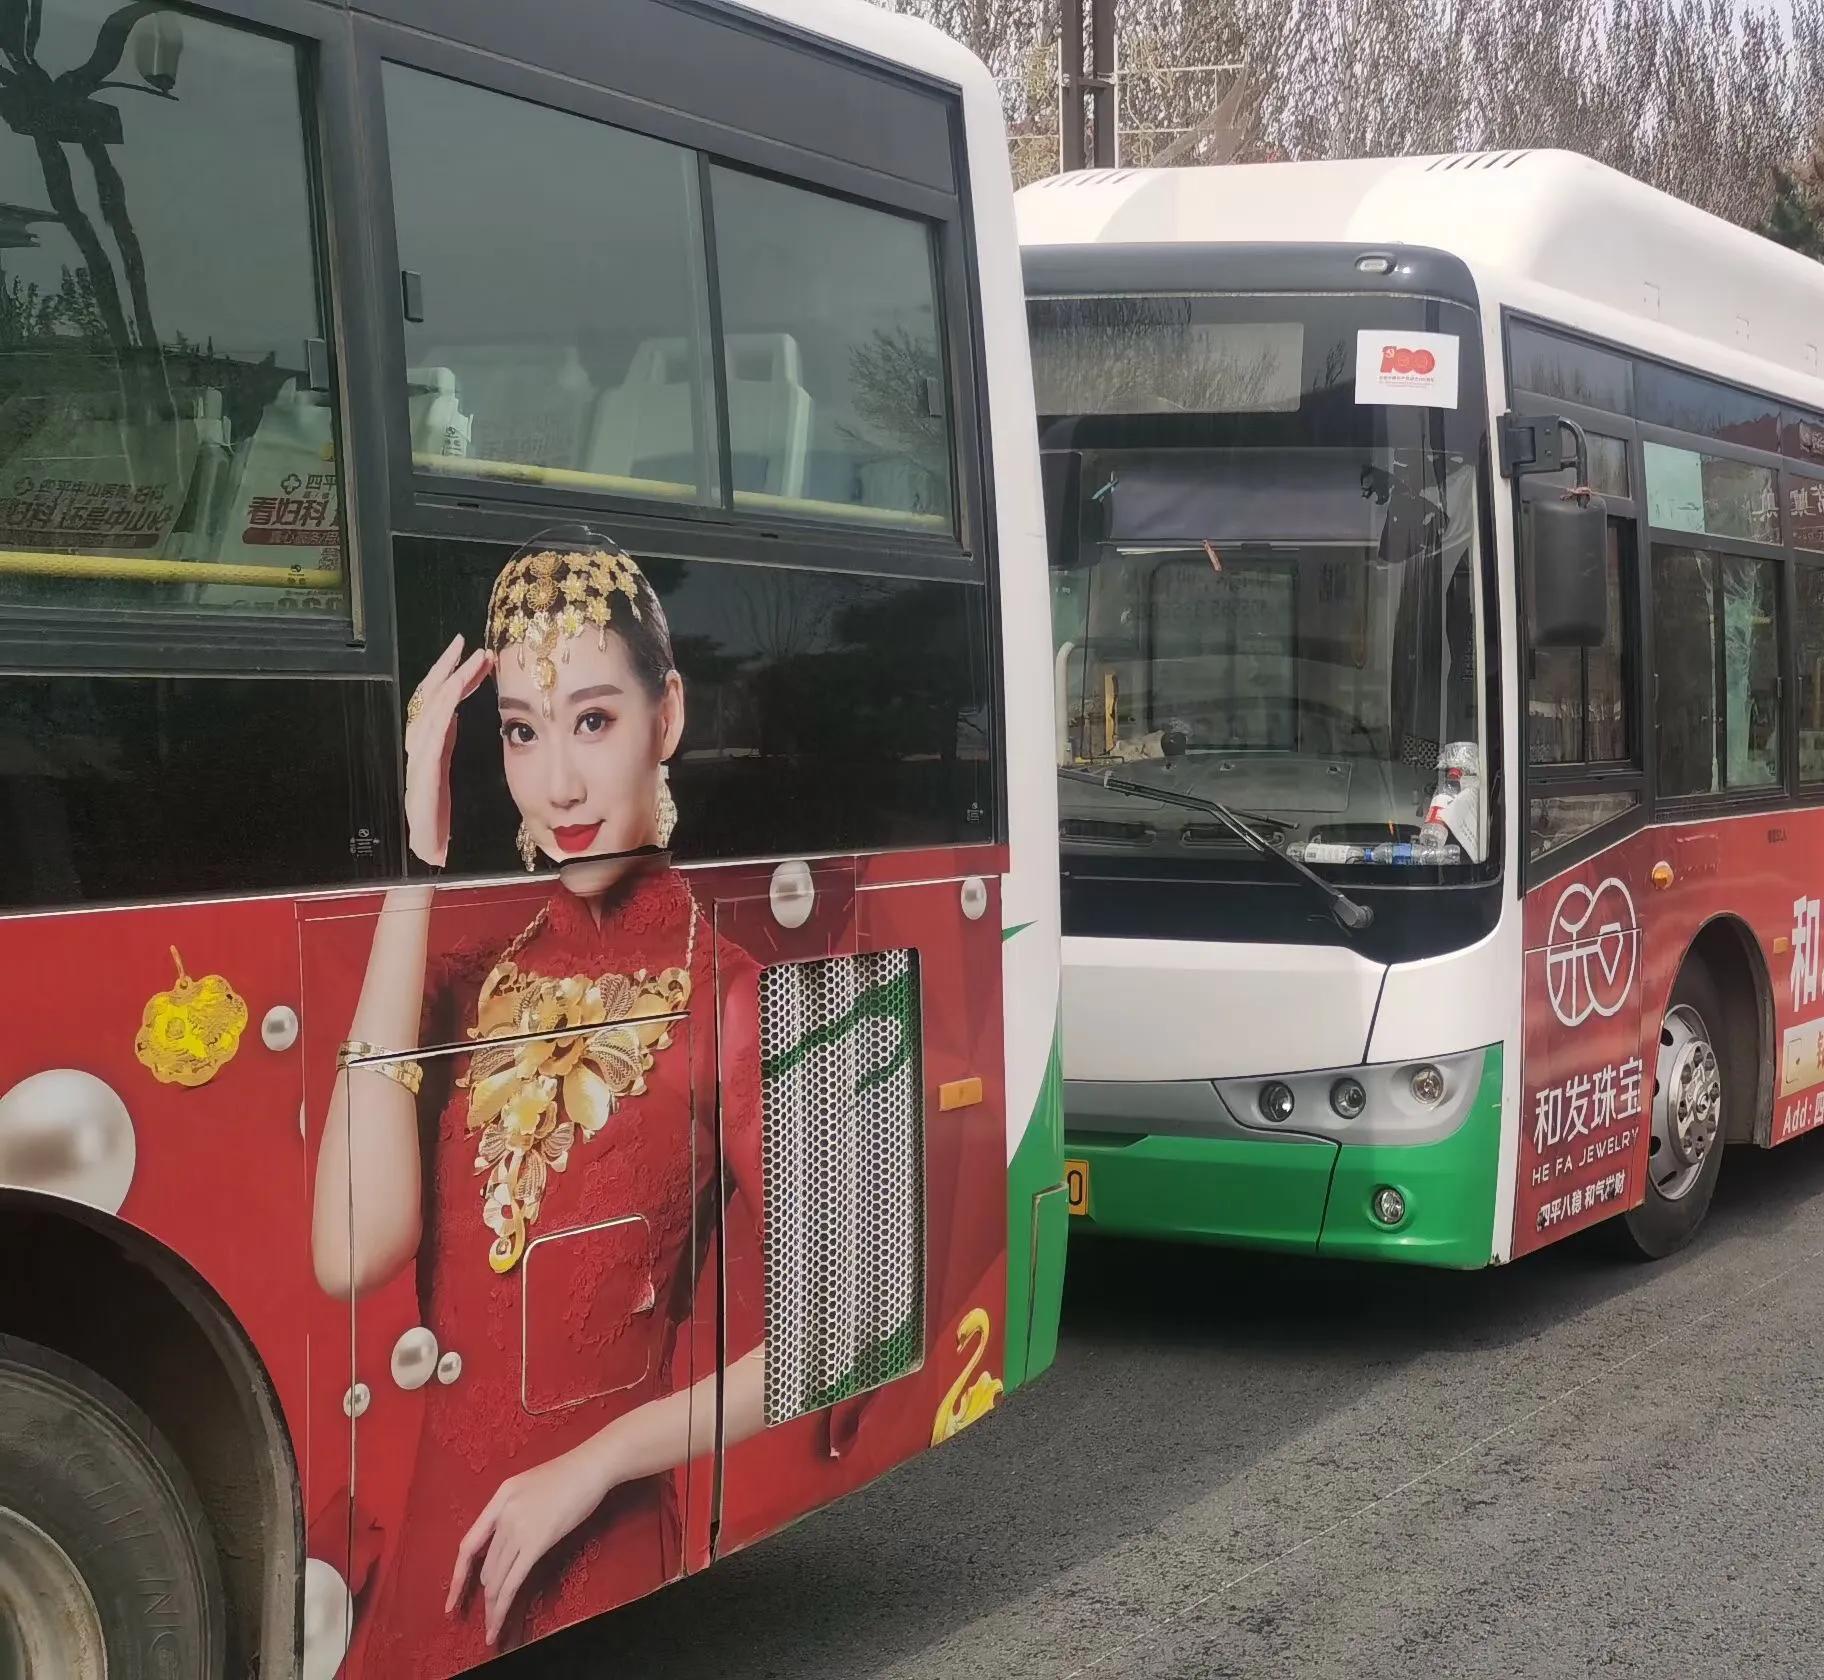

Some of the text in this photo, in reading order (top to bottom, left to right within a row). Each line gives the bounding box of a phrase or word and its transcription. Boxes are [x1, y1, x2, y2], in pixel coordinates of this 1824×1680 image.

[248, 496, 329, 527] 看妇科
[1534, 1057, 1642, 1154] 和发珠宝
[1532, 1127, 1640, 1186] HE FA JEWELRY
